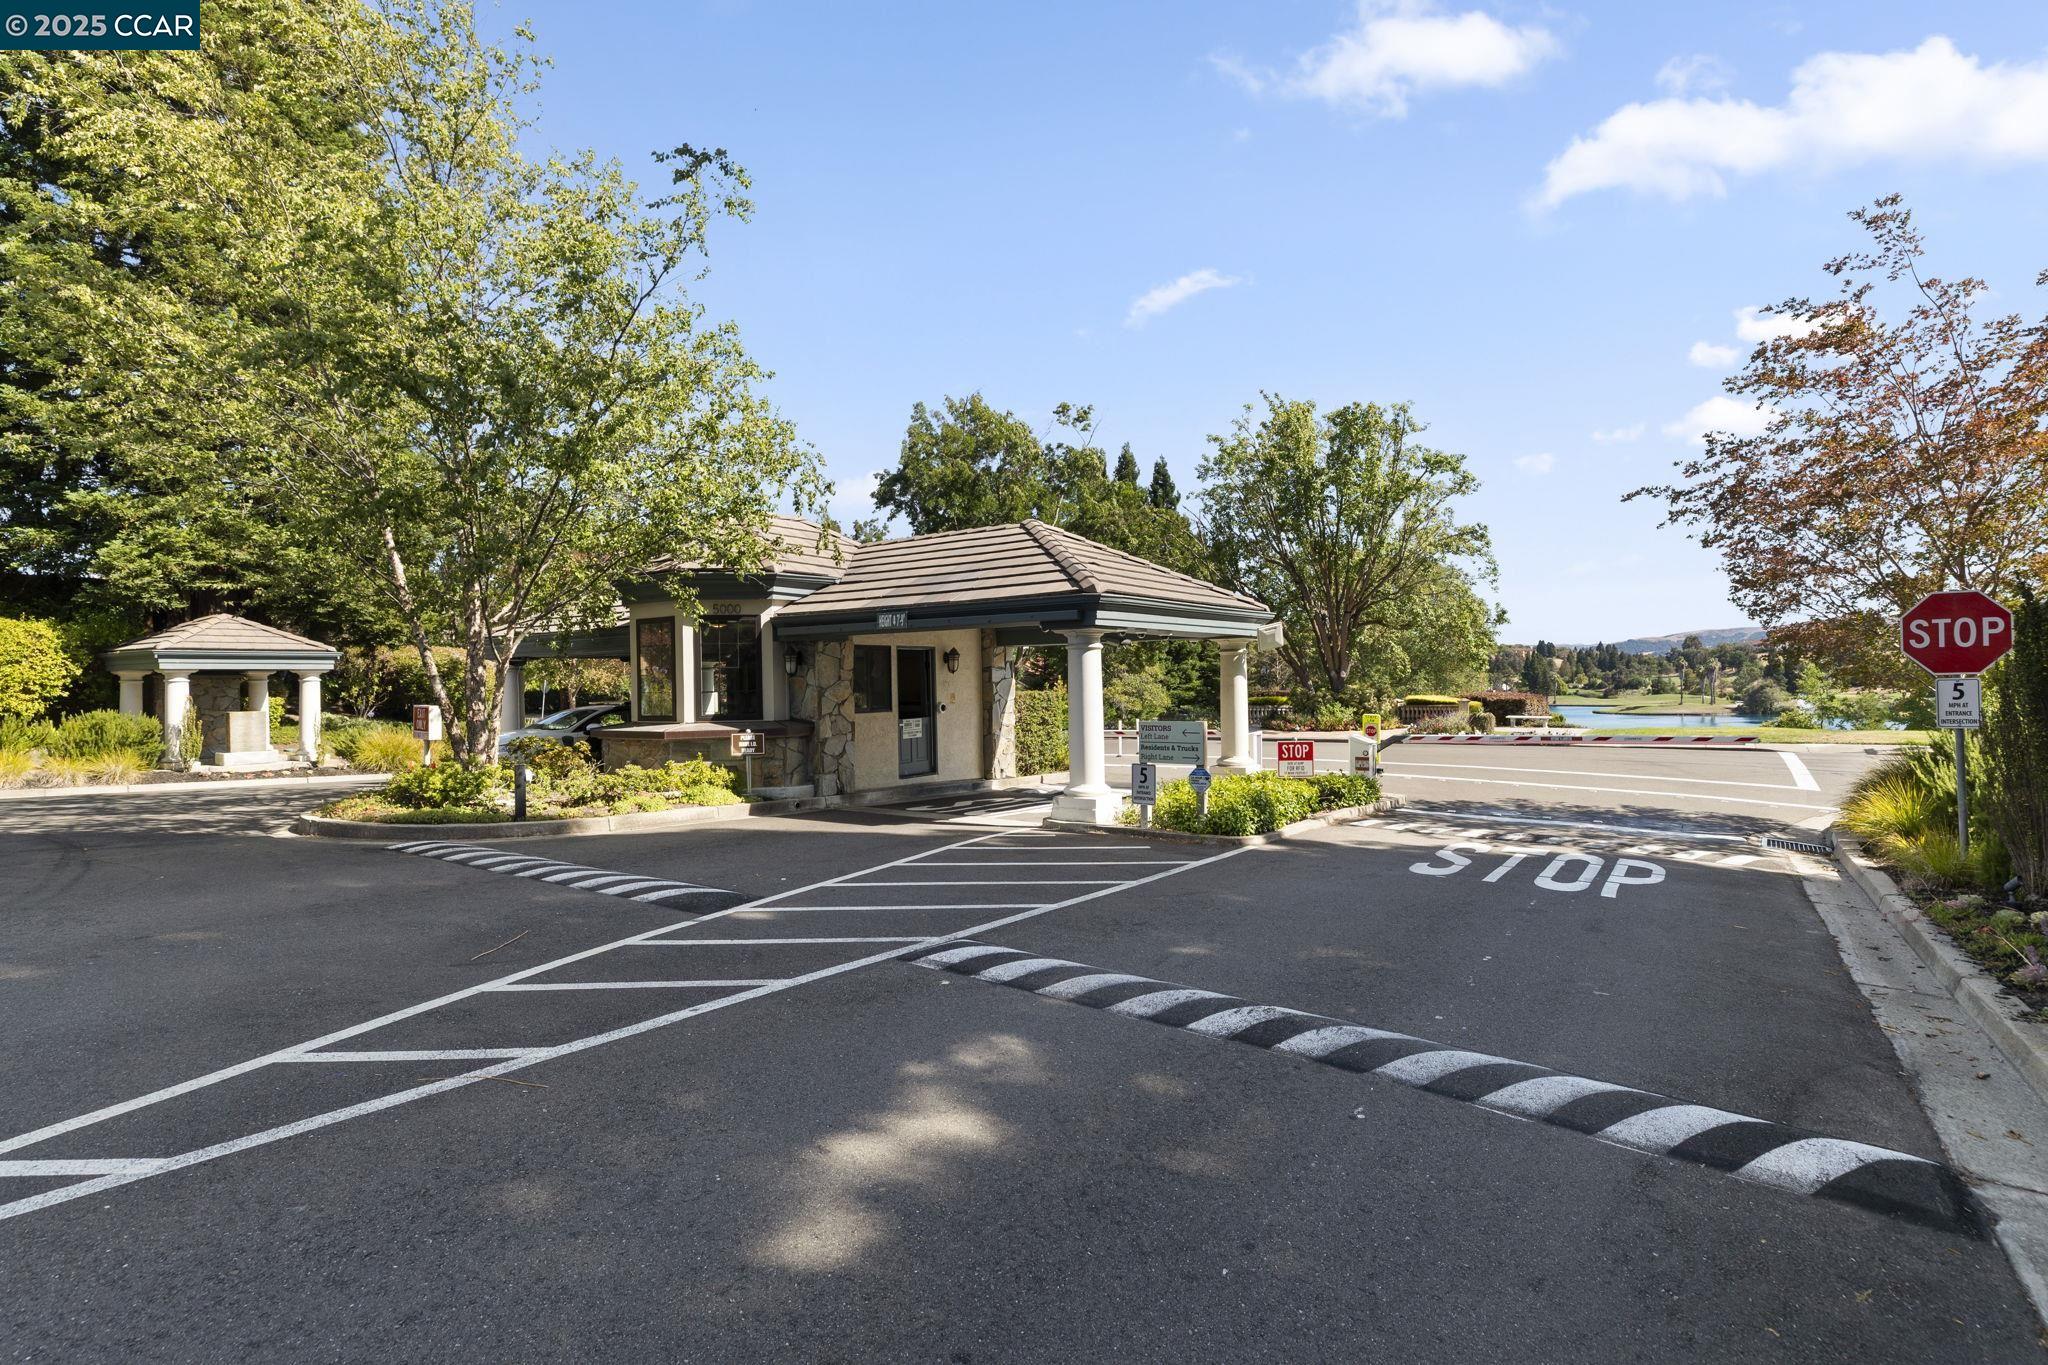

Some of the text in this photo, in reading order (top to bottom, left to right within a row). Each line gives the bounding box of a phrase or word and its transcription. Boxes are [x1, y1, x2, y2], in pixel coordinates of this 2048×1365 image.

[712, 603, 741, 615] 5000
[1909, 616, 2006, 649] STOP
[1952, 682, 1965, 700] 5
[1140, 753, 1157, 761] Right
[1281, 744, 1310, 759] STOP
[1139, 767, 1148, 784] 5
[1408, 841, 1667, 899] STOP
